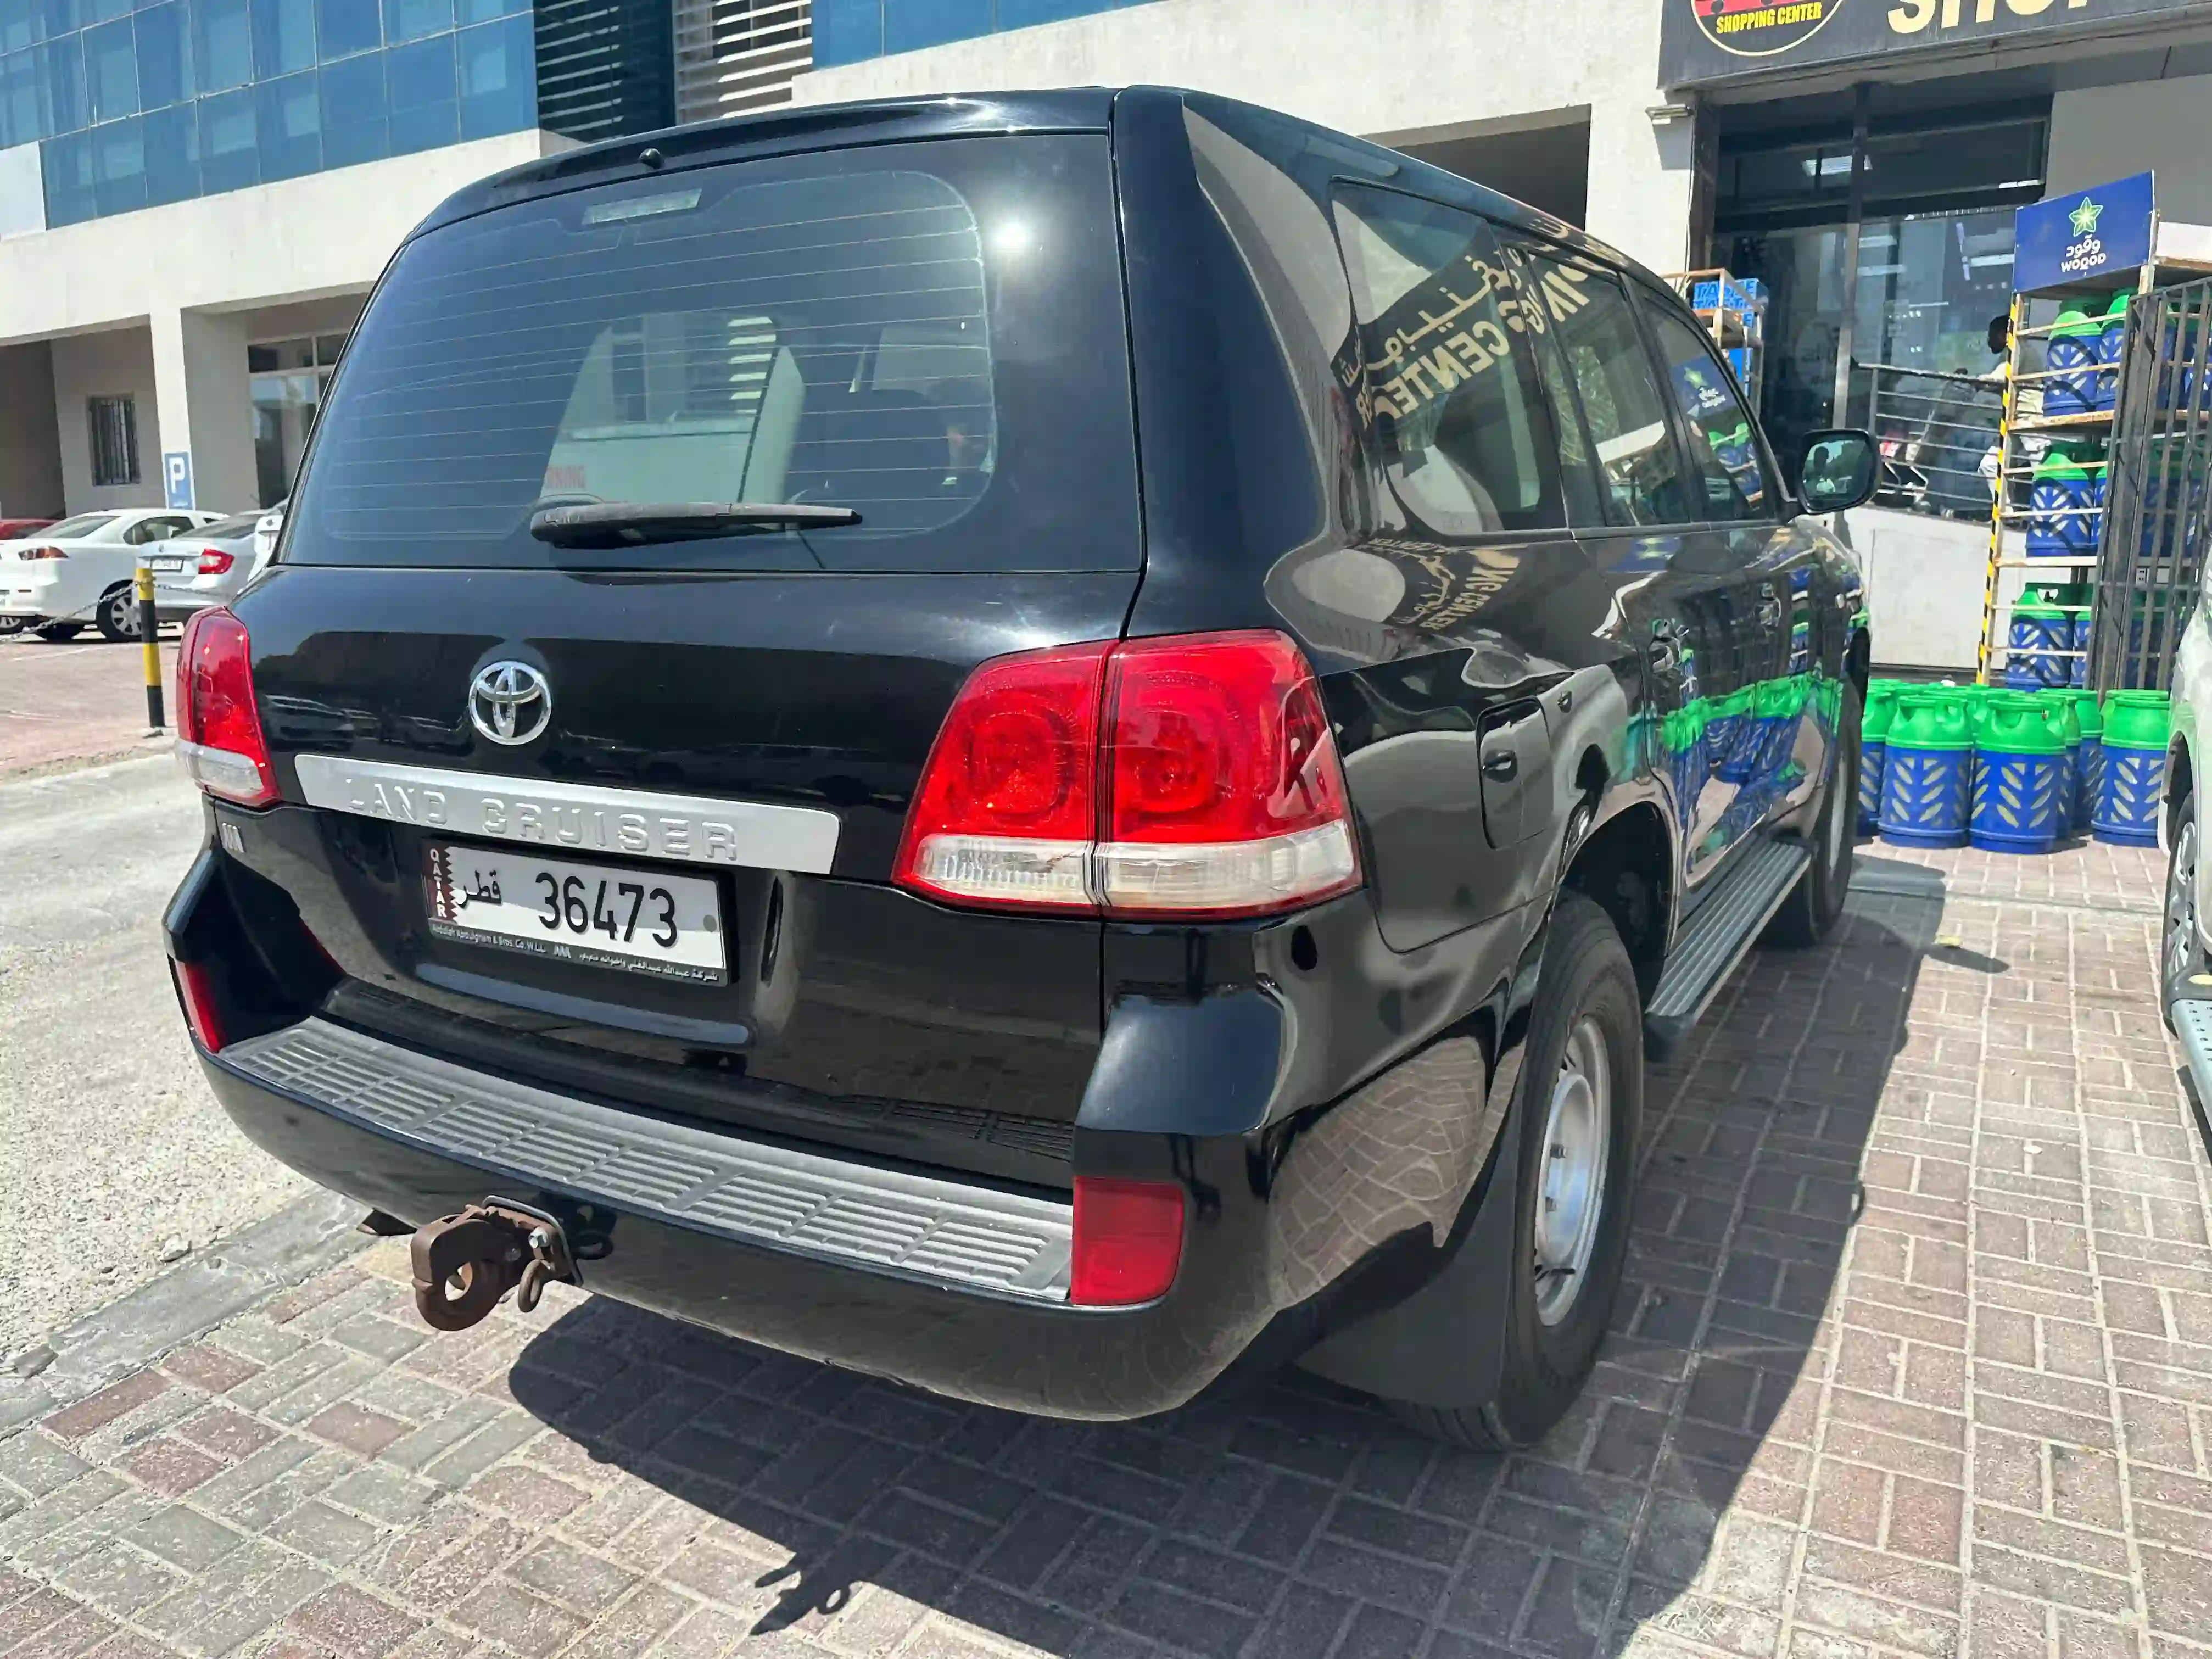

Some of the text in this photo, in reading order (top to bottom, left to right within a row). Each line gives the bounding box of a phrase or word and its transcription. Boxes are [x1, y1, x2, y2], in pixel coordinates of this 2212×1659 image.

[1716, 2, 1823, 35] SHOPPING CENTER
[2060, 253, 2107, 272] WOQOD
[168, 457, 186, 494] P
[346, 778, 739, 862] LAND CRUISER
[429, 848, 448, 918] QATAR
[454, 869, 502, 909] قطر
[535, 872, 679, 948] 36473
